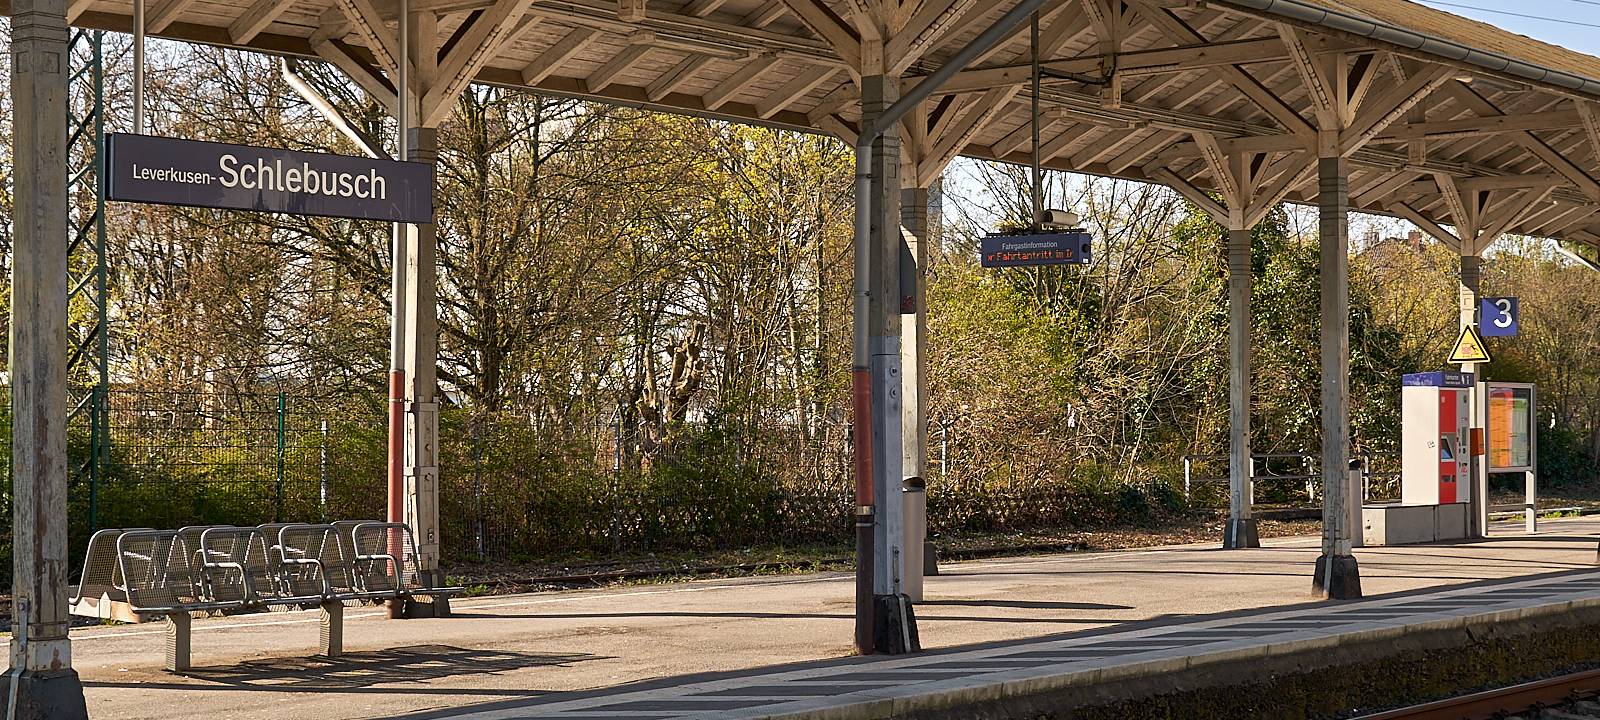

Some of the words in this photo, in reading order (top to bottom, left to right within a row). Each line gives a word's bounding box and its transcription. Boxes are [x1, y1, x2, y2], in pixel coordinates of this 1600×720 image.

[132, 163, 217, 186] Leverkusen-
[218, 153, 387, 200] Schlebusch
[996, 250, 1052, 261] Fahrtantritt
[1002, 241, 1058, 250] Fahrgastinformation
[1493, 298, 1513, 328] 3
